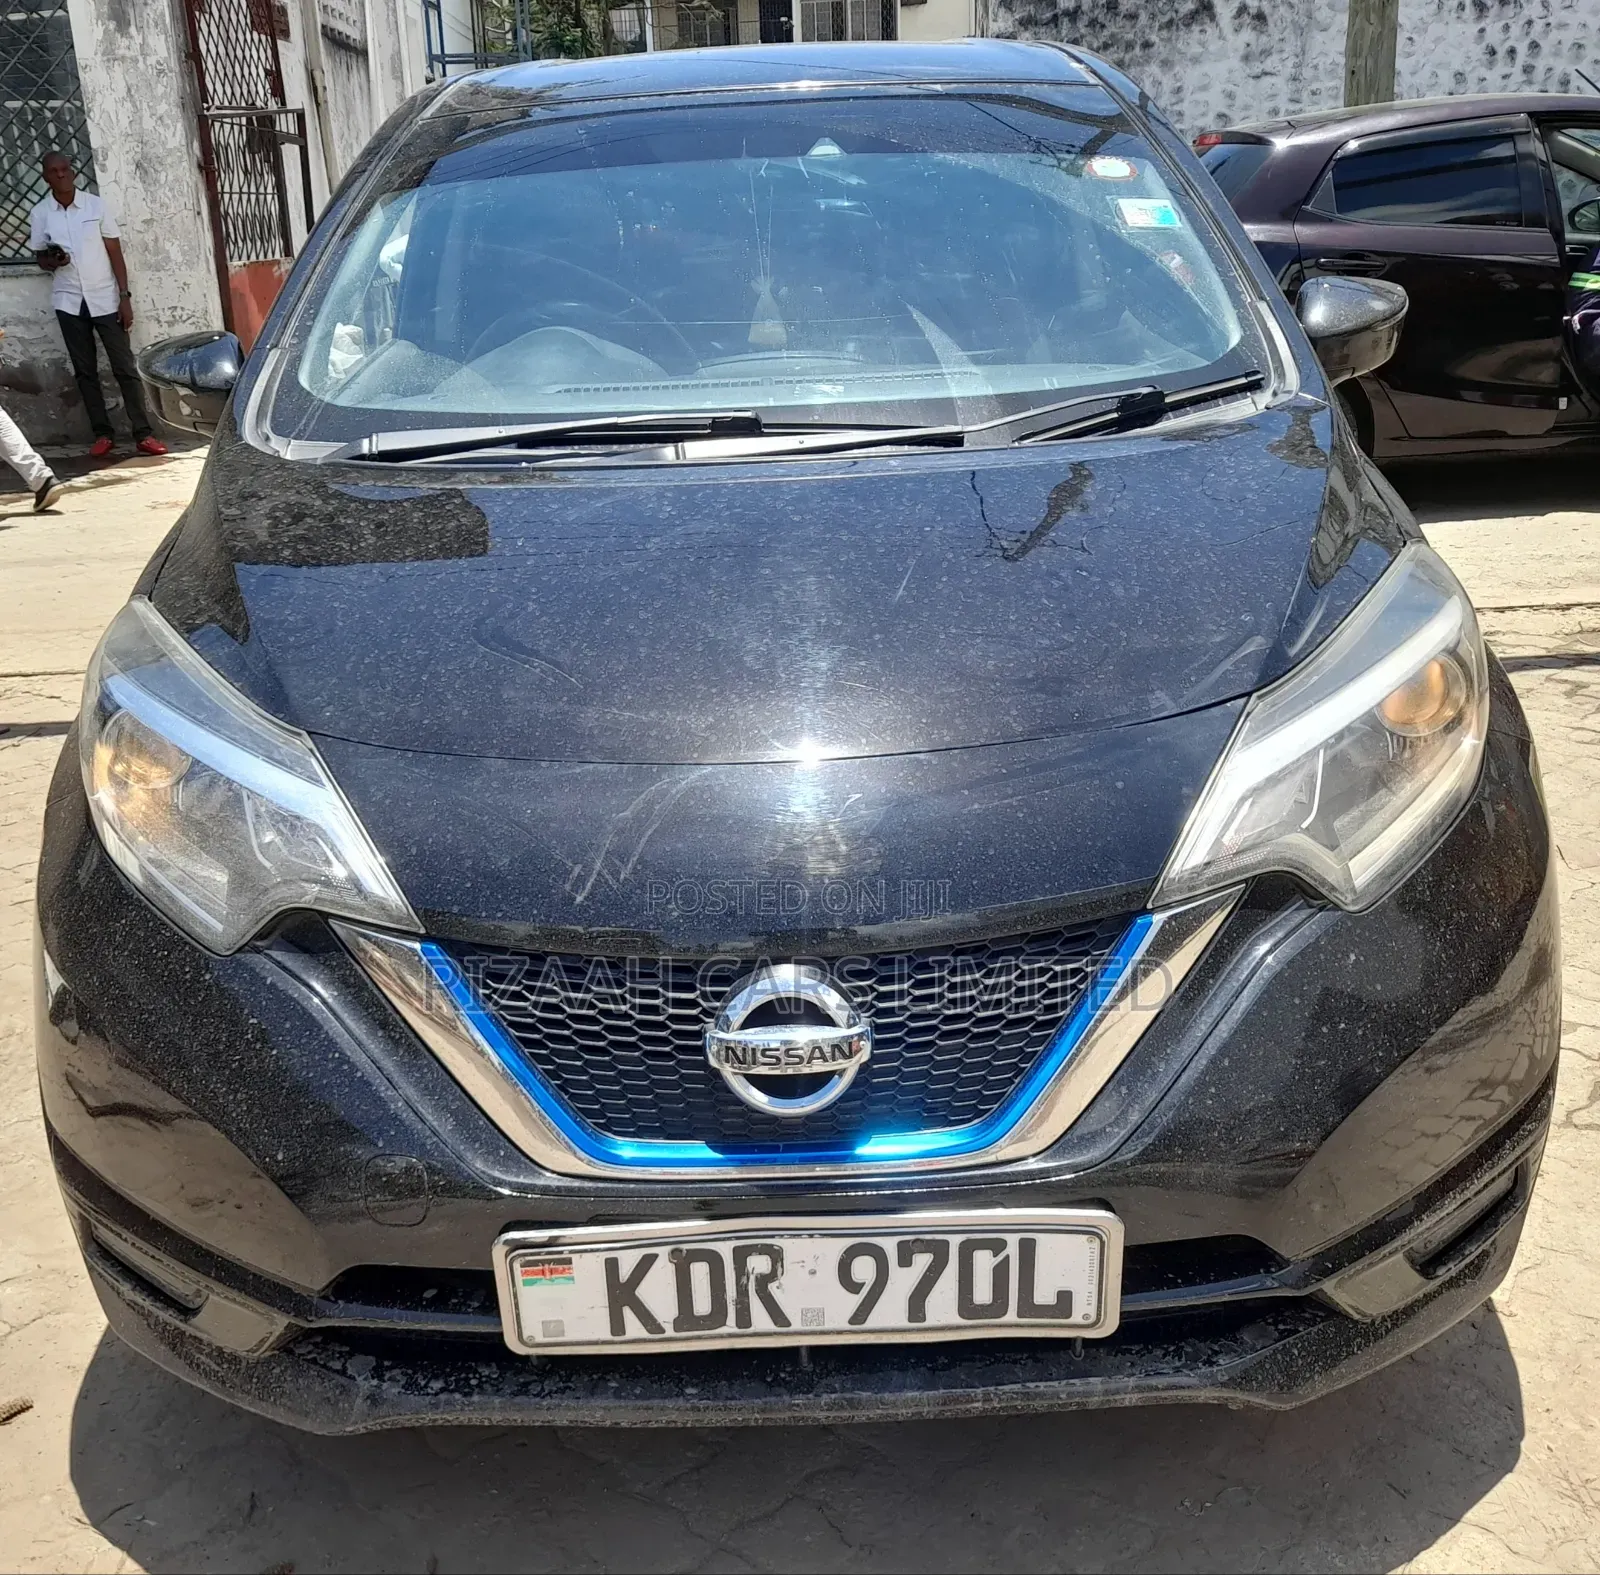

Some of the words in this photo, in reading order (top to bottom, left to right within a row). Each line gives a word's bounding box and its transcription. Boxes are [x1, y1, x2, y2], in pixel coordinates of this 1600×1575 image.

[724, 1041, 855, 1066] NISSAN
[604, 1242, 793, 1337] KDR
[837, 1236, 1074, 1326] 970L
